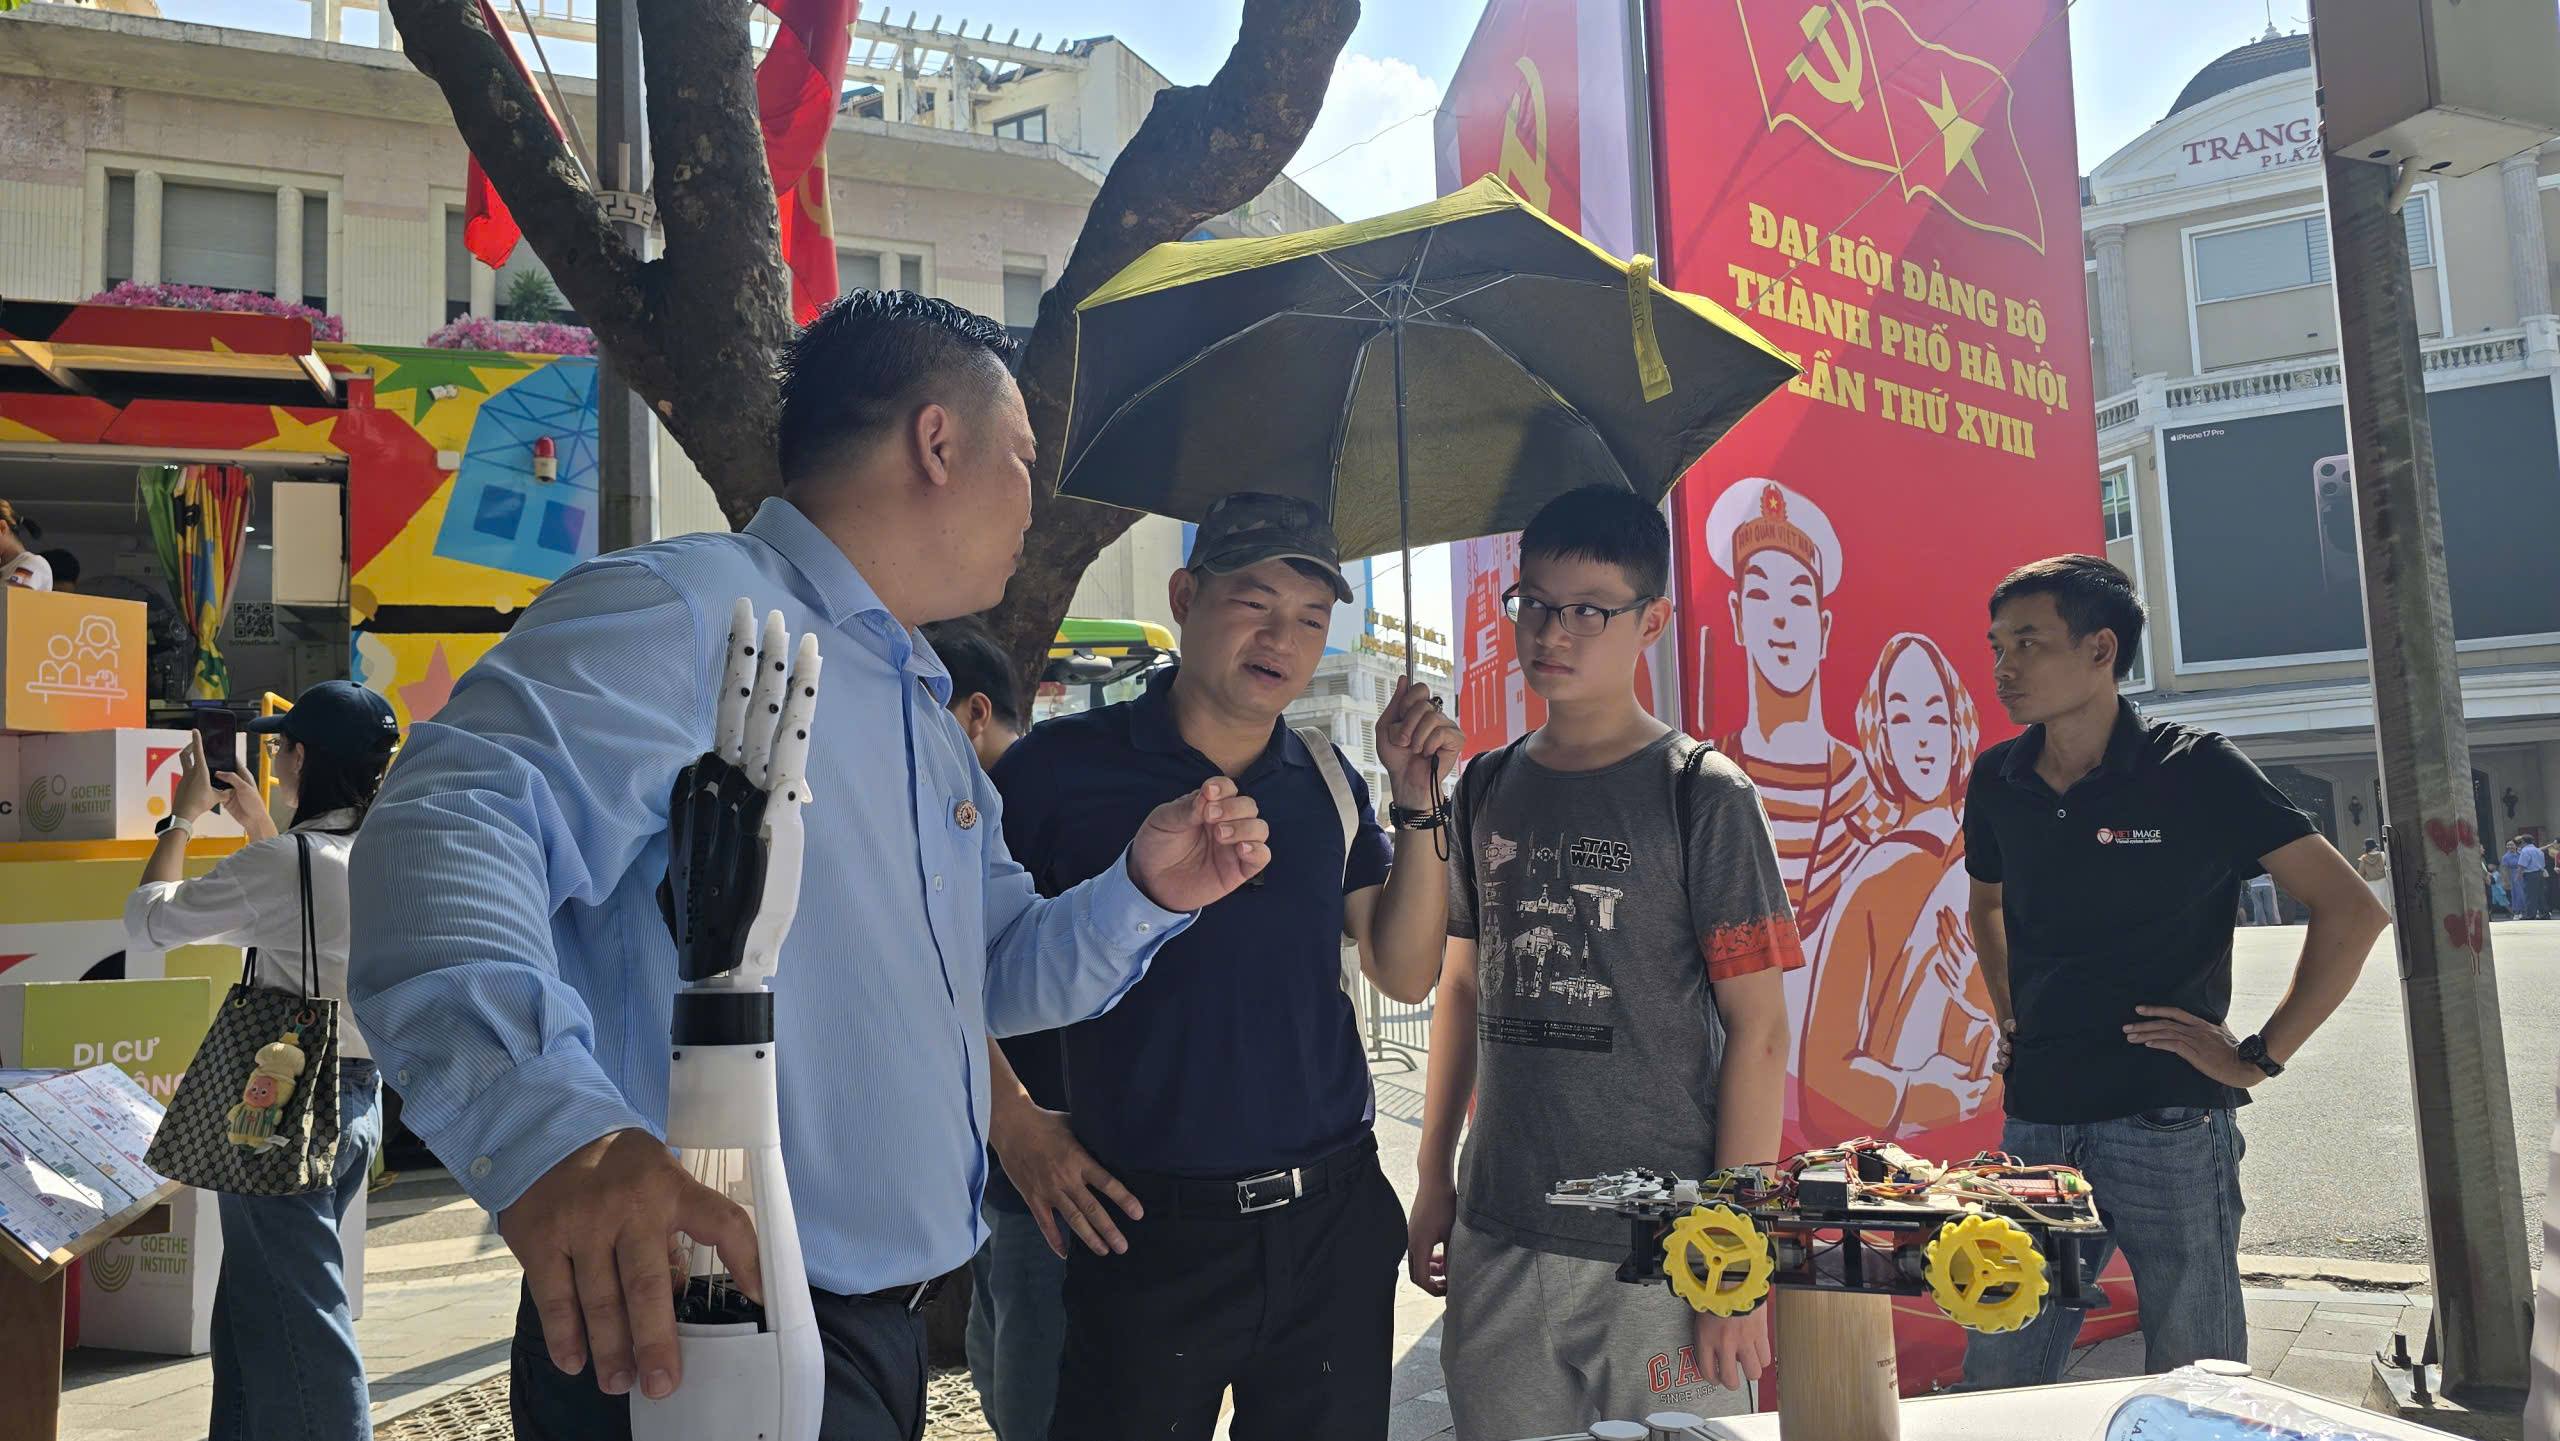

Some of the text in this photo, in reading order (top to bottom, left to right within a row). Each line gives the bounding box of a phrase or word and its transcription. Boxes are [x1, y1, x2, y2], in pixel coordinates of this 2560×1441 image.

[2182, 118, 2312, 166] TRANG
[2261, 144, 2320, 168] PLAZ
[1749, 202, 2047, 353] ĐẠI HỘI ĐẢNG BỘ
[1728, 263, 2070, 415] THÀNH PHỐ HÀ NỘI
[1787, 348, 2036, 459] LẦN THỨ XVIII
[2176, 432, 2203, 441] iPhone
[71, 784, 112, 799] GOETHE
[71, 799, 112, 814] INSTITUT
[2132, 829, 2161, 838] IMAGE
[1571, 836, 1631, 858] STAR
[1571, 850, 1631, 874] WARS
[112, 1037, 160, 1063] CƯ
[141, 1235, 188, 1254] GOETHE
[140, 1256, 188, 1274] INSTITUT
[1647, 1344, 1703, 1393] GA
[1660, 1391, 1692, 1404] SINCE
